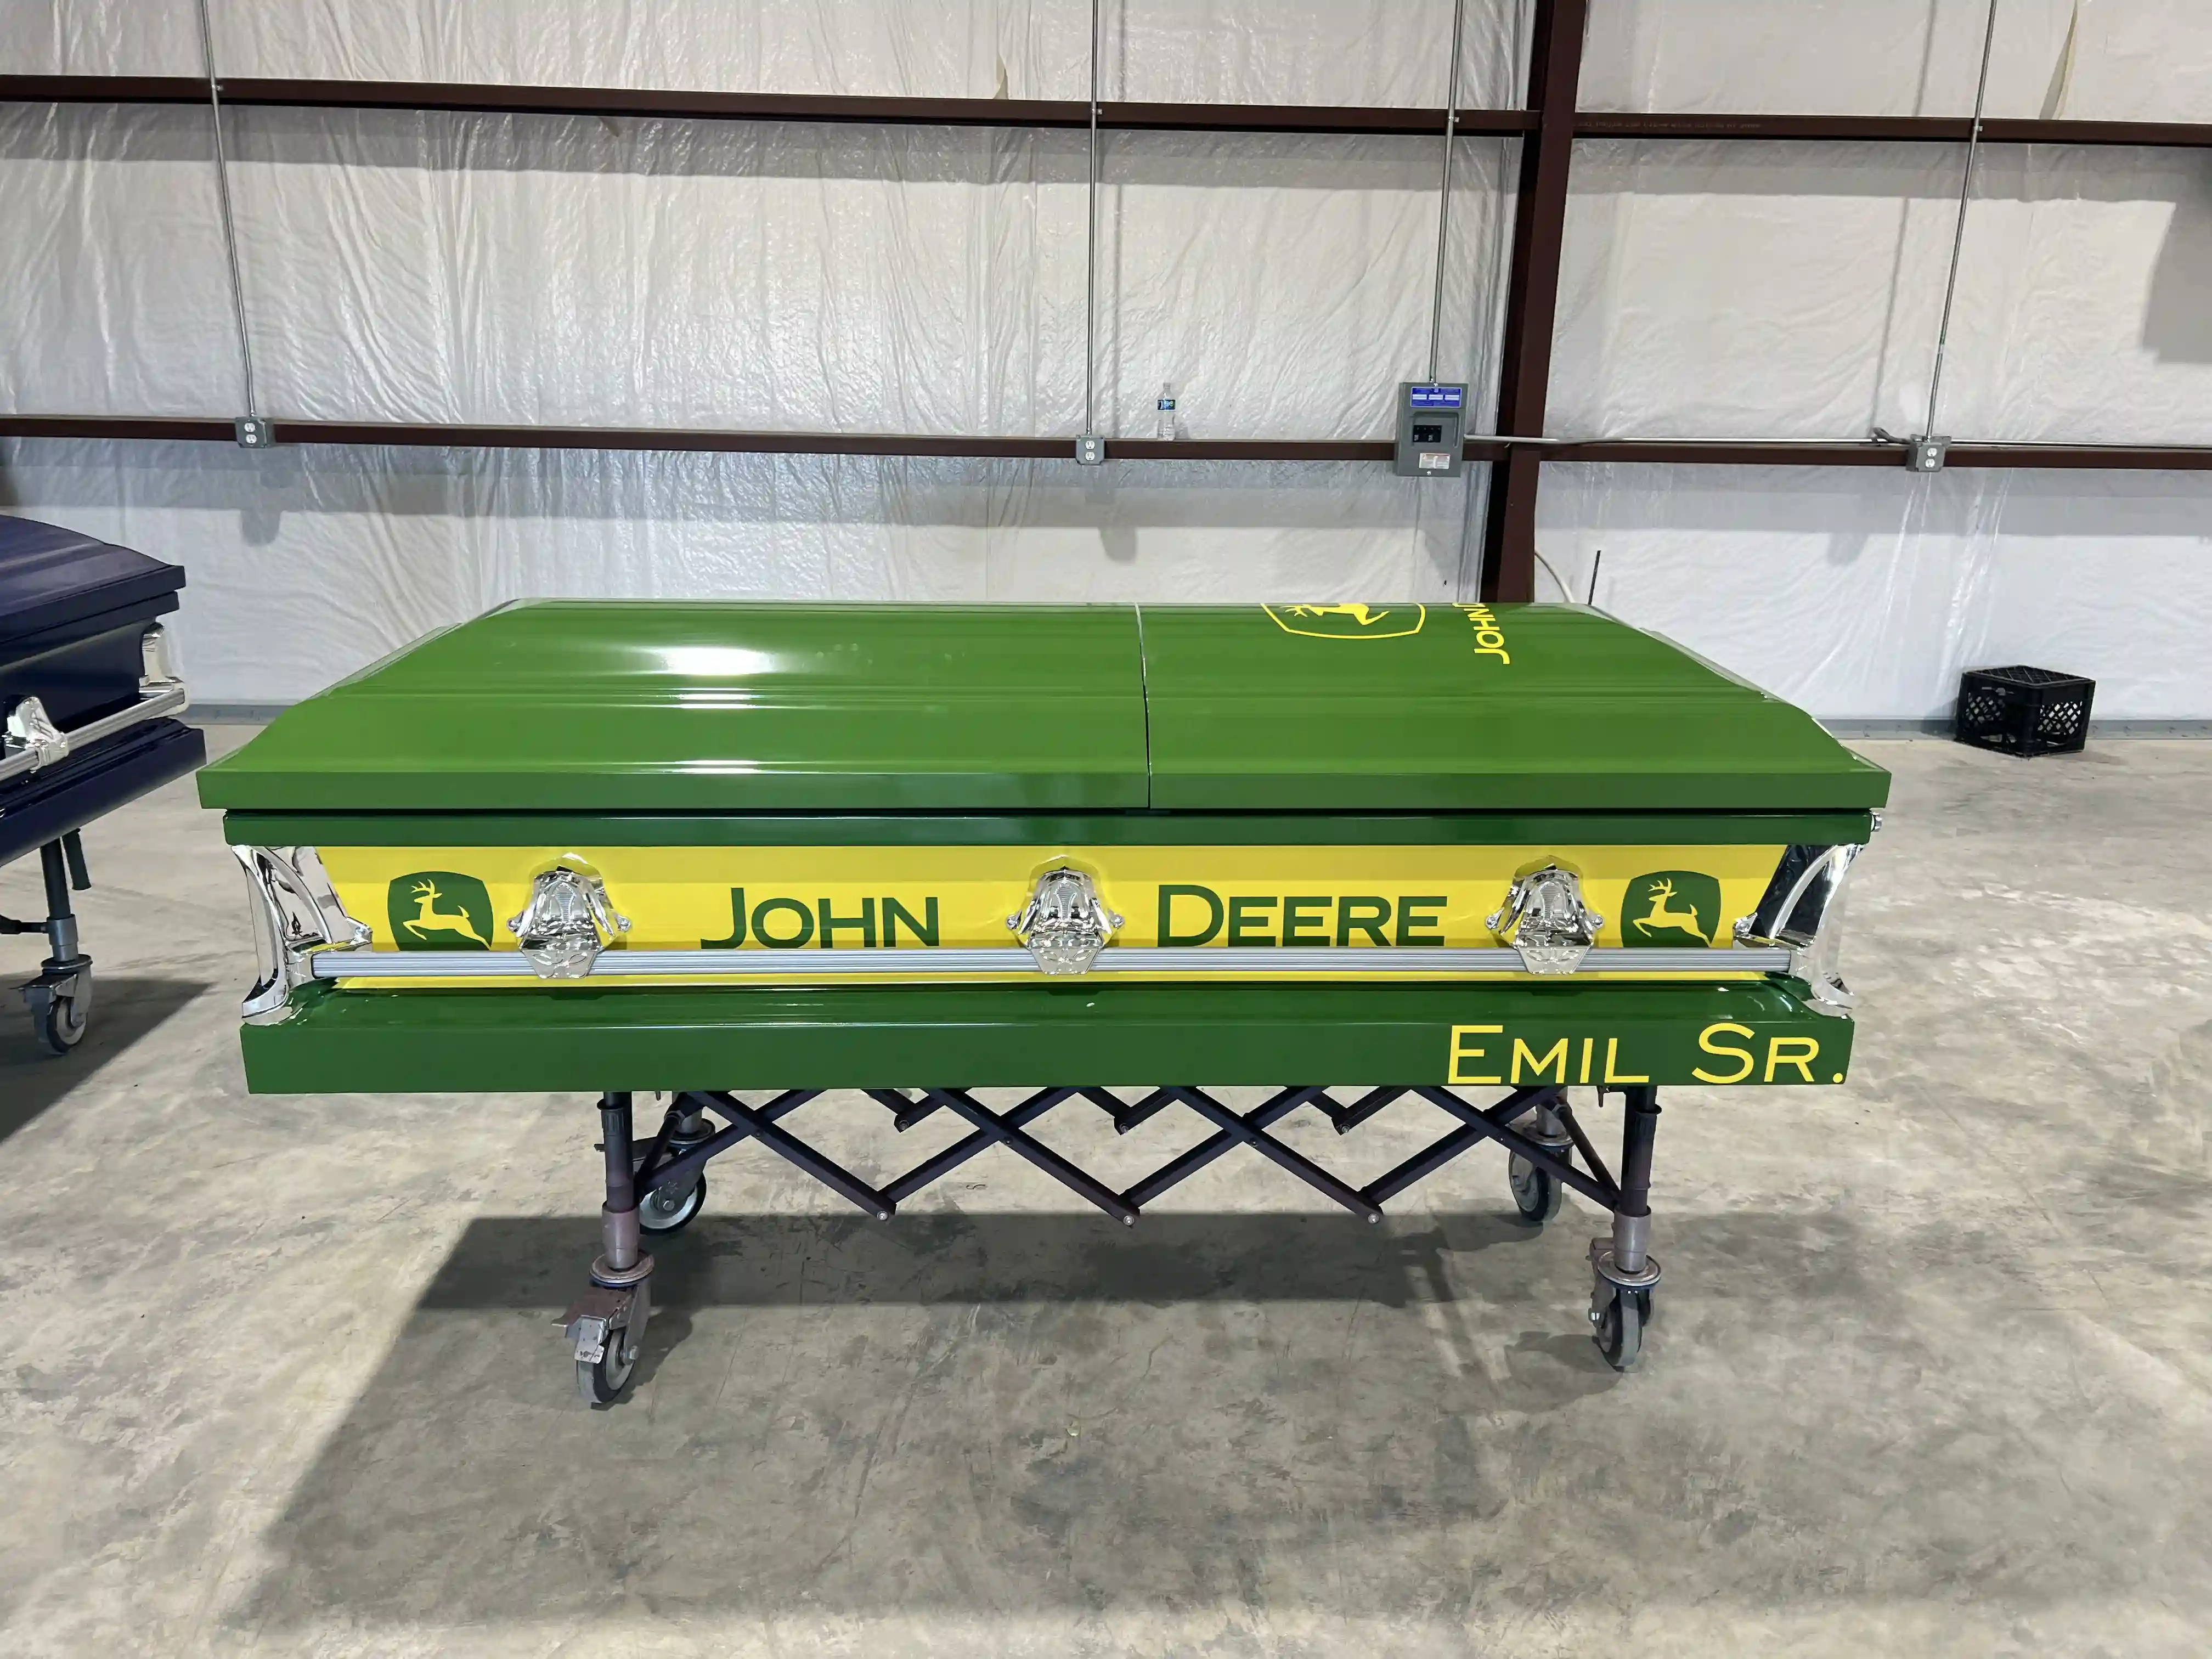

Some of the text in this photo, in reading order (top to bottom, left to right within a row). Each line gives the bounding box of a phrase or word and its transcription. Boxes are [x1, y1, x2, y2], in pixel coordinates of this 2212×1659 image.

[1463, 608, 1510, 664] JOHN
[701, 884, 1448, 949] JOHN DEERE
[1447, 1023, 1843, 1084] EMIL SR.
